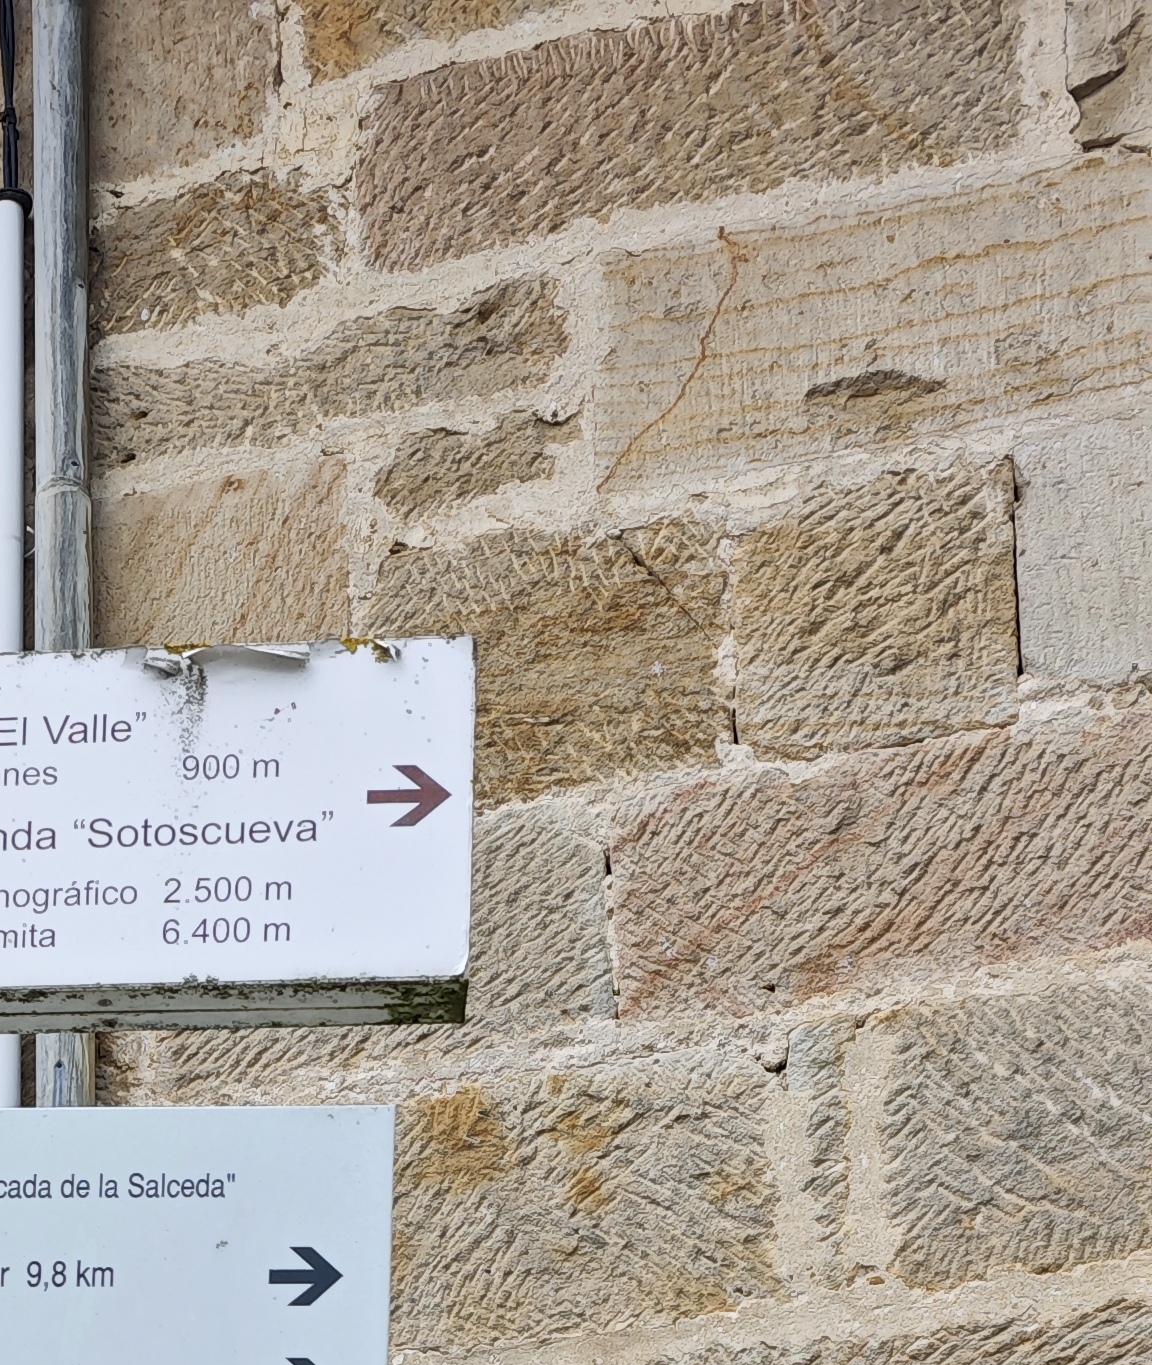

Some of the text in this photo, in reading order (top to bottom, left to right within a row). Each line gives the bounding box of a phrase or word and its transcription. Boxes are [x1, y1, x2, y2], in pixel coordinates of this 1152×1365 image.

[42, 711, 147, 745] Valle”
[181, 754, 240, 781] 900
[252, 758, 280, 779] m
[73, 810, 334, 849] “Sotoscueva”
[163, 876, 253, 904] 2.500
[264, 880, 292, 901] m
[162, 917, 251, 946] 6.400
[263, 922, 291, 943] m
[60, 1173, 91, 1199] de
[98, 1172, 120, 1199] la
[127, 1172, 236, 1199] Salceda"
[26, 1260, 67, 1292] 9,8
[75, 1259, 114, 1288] km
